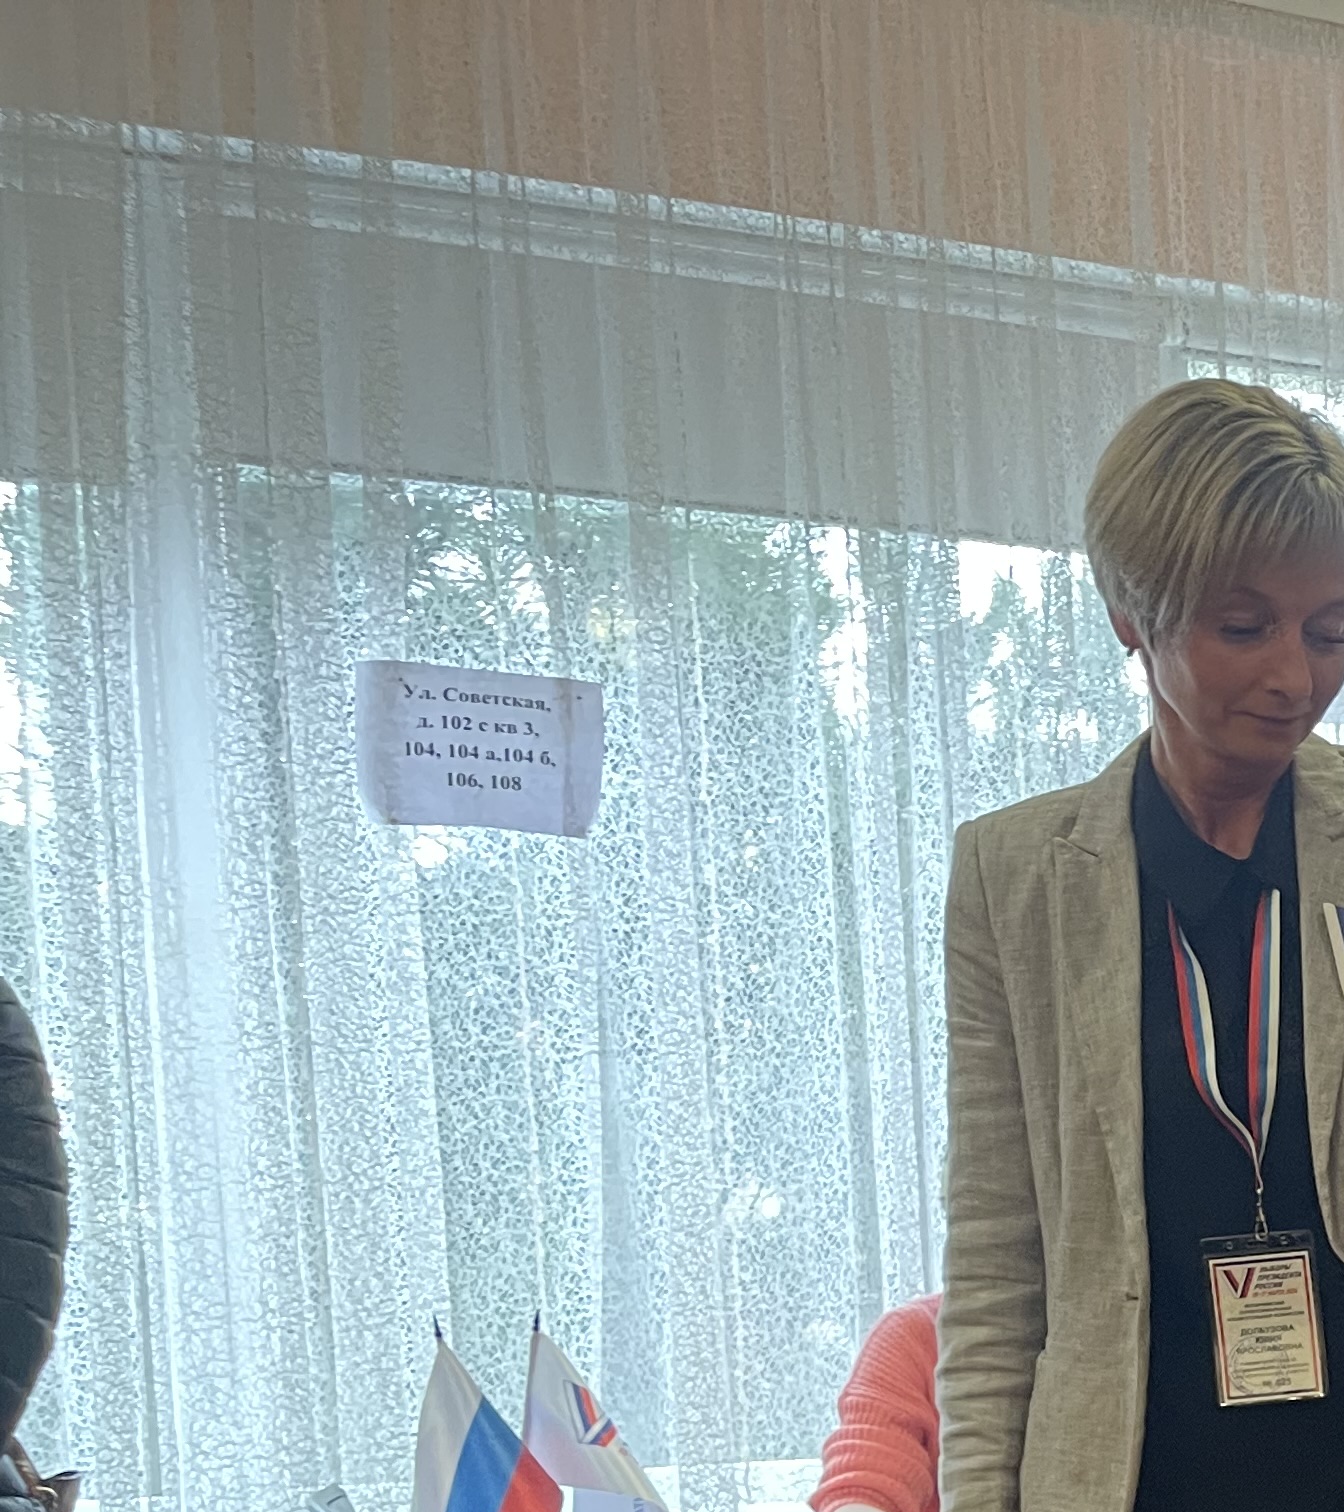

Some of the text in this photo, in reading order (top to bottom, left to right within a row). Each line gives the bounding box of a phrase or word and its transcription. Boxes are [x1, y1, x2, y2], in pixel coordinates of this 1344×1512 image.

[403, 684, 551, 712] Ул. Советская,
[416, 717, 434, 729] д.
[442, 716, 472, 731] 102
[405, 742, 441, 759] 104,
[449, 744, 479, 759] 104
[447, 772, 522, 791] 106, 108
